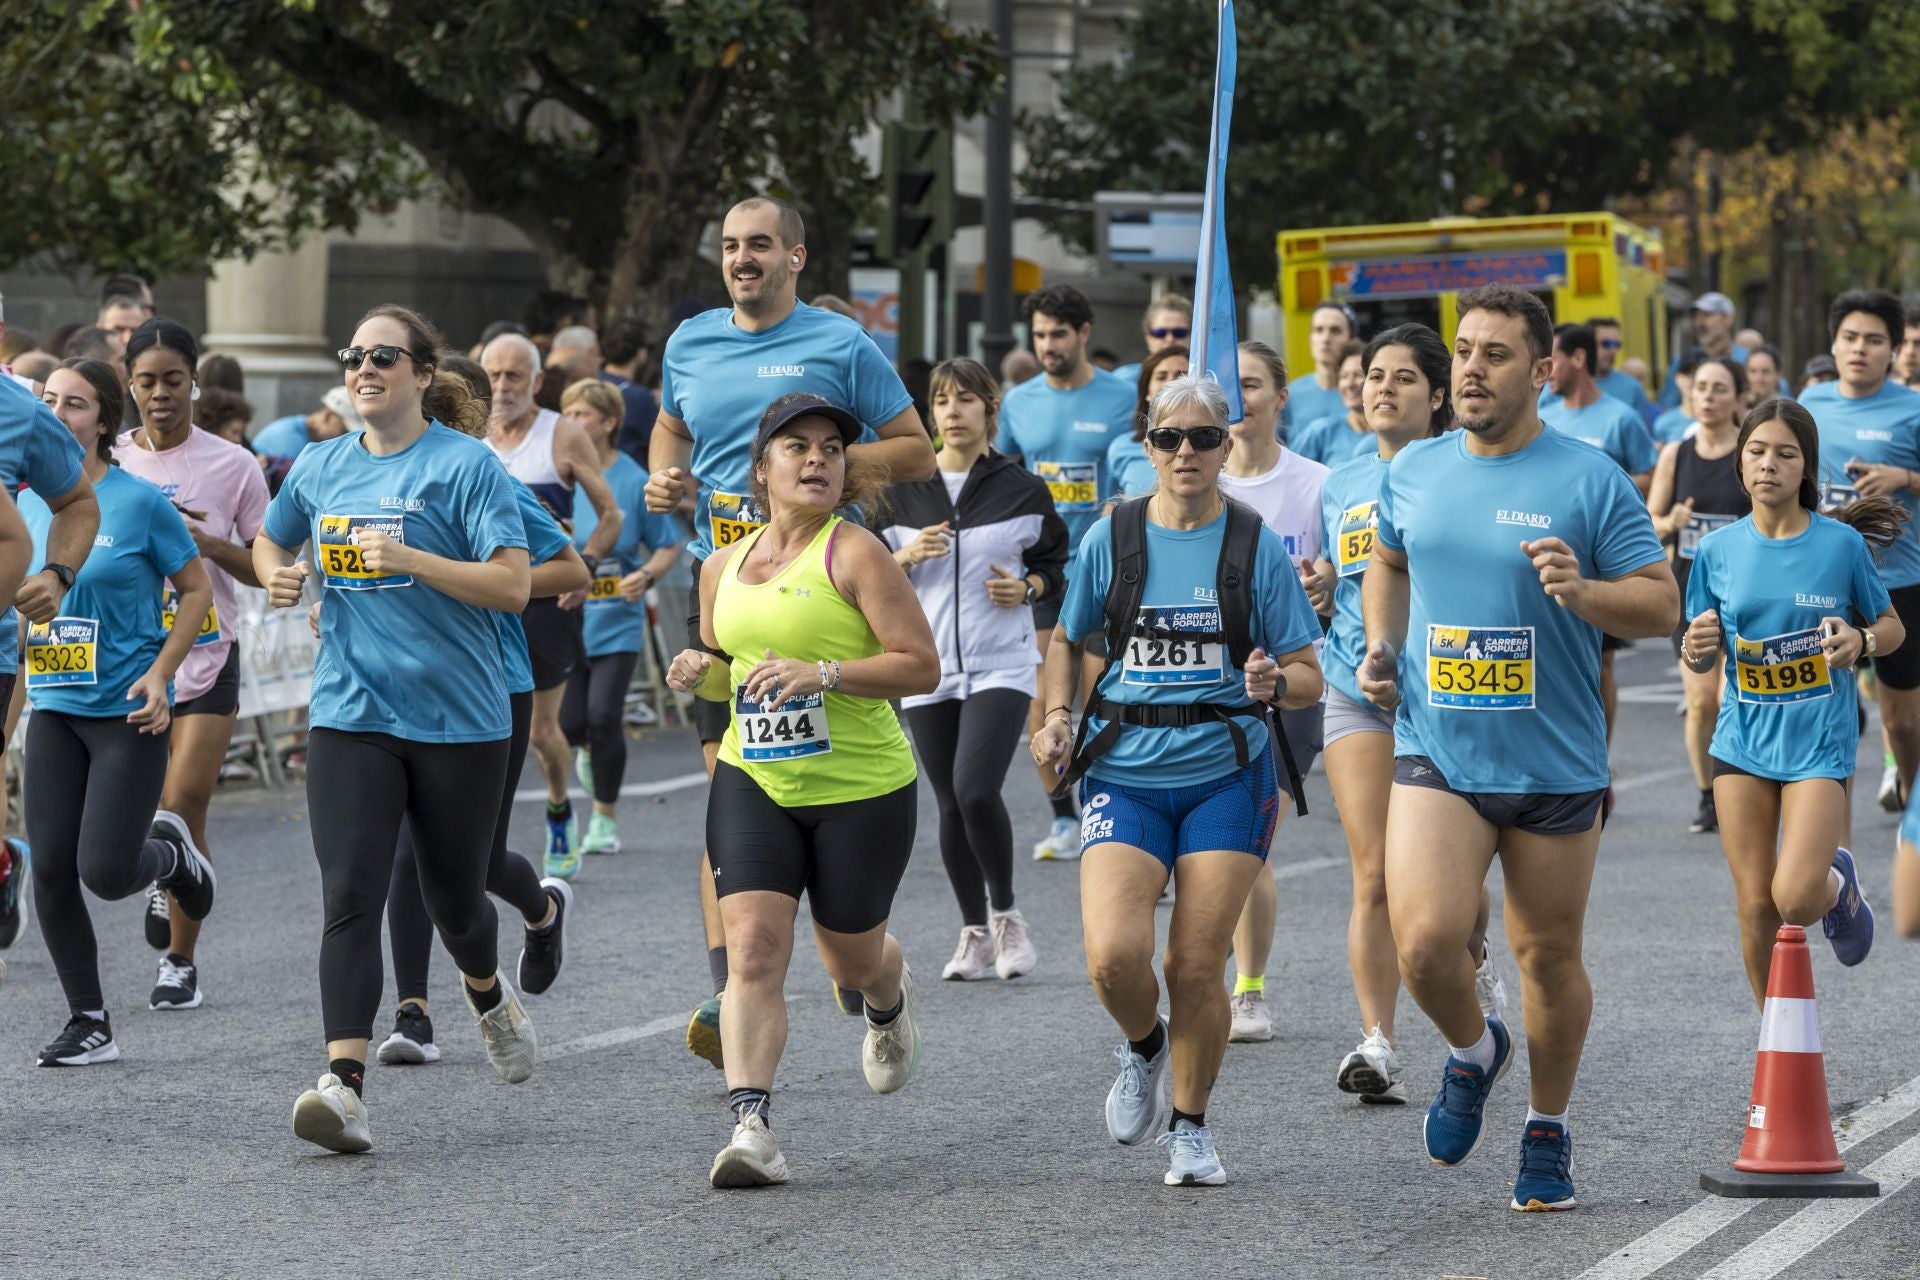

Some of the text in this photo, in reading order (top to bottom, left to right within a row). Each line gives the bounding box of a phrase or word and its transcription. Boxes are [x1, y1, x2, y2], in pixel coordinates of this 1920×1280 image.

[757, 366, 770, 375] EL
[770, 365, 805, 375] DIARIO
[380, 496, 392, 506] EL
[393, 496, 426, 509] DIARIO
[1496, 510, 1510, 520] EL
[1511, 510, 1552, 526] DIARIO
[327, 525, 340, 536] 5K
[720, 522, 760, 545] 52
[1795, 593, 1809, 603] EL
[1173, 612, 1218, 621] CARRERA
[1172, 619, 1218, 628] POPULAR
[59, 630, 92, 639] POPULAR
[60, 625, 93, 634] CARRERA
[1440, 638, 1455, 649] 5K
[1485, 637, 1529, 646] CARRERA
[1780, 634, 1820, 649] CARRERA
[1130, 640, 1207, 667] 1261
[1483, 645, 1529, 653] POPULAR
[1780, 641, 1821, 656] POPULAR
[33, 646, 88, 673] 5323
[1513, 652, 1528, 660] DM
[1437, 661, 1524, 693] 5345
[1745, 661, 1817, 690] 5198
[805, 700, 819, 708] DM
[745, 713, 815, 744] 1244
